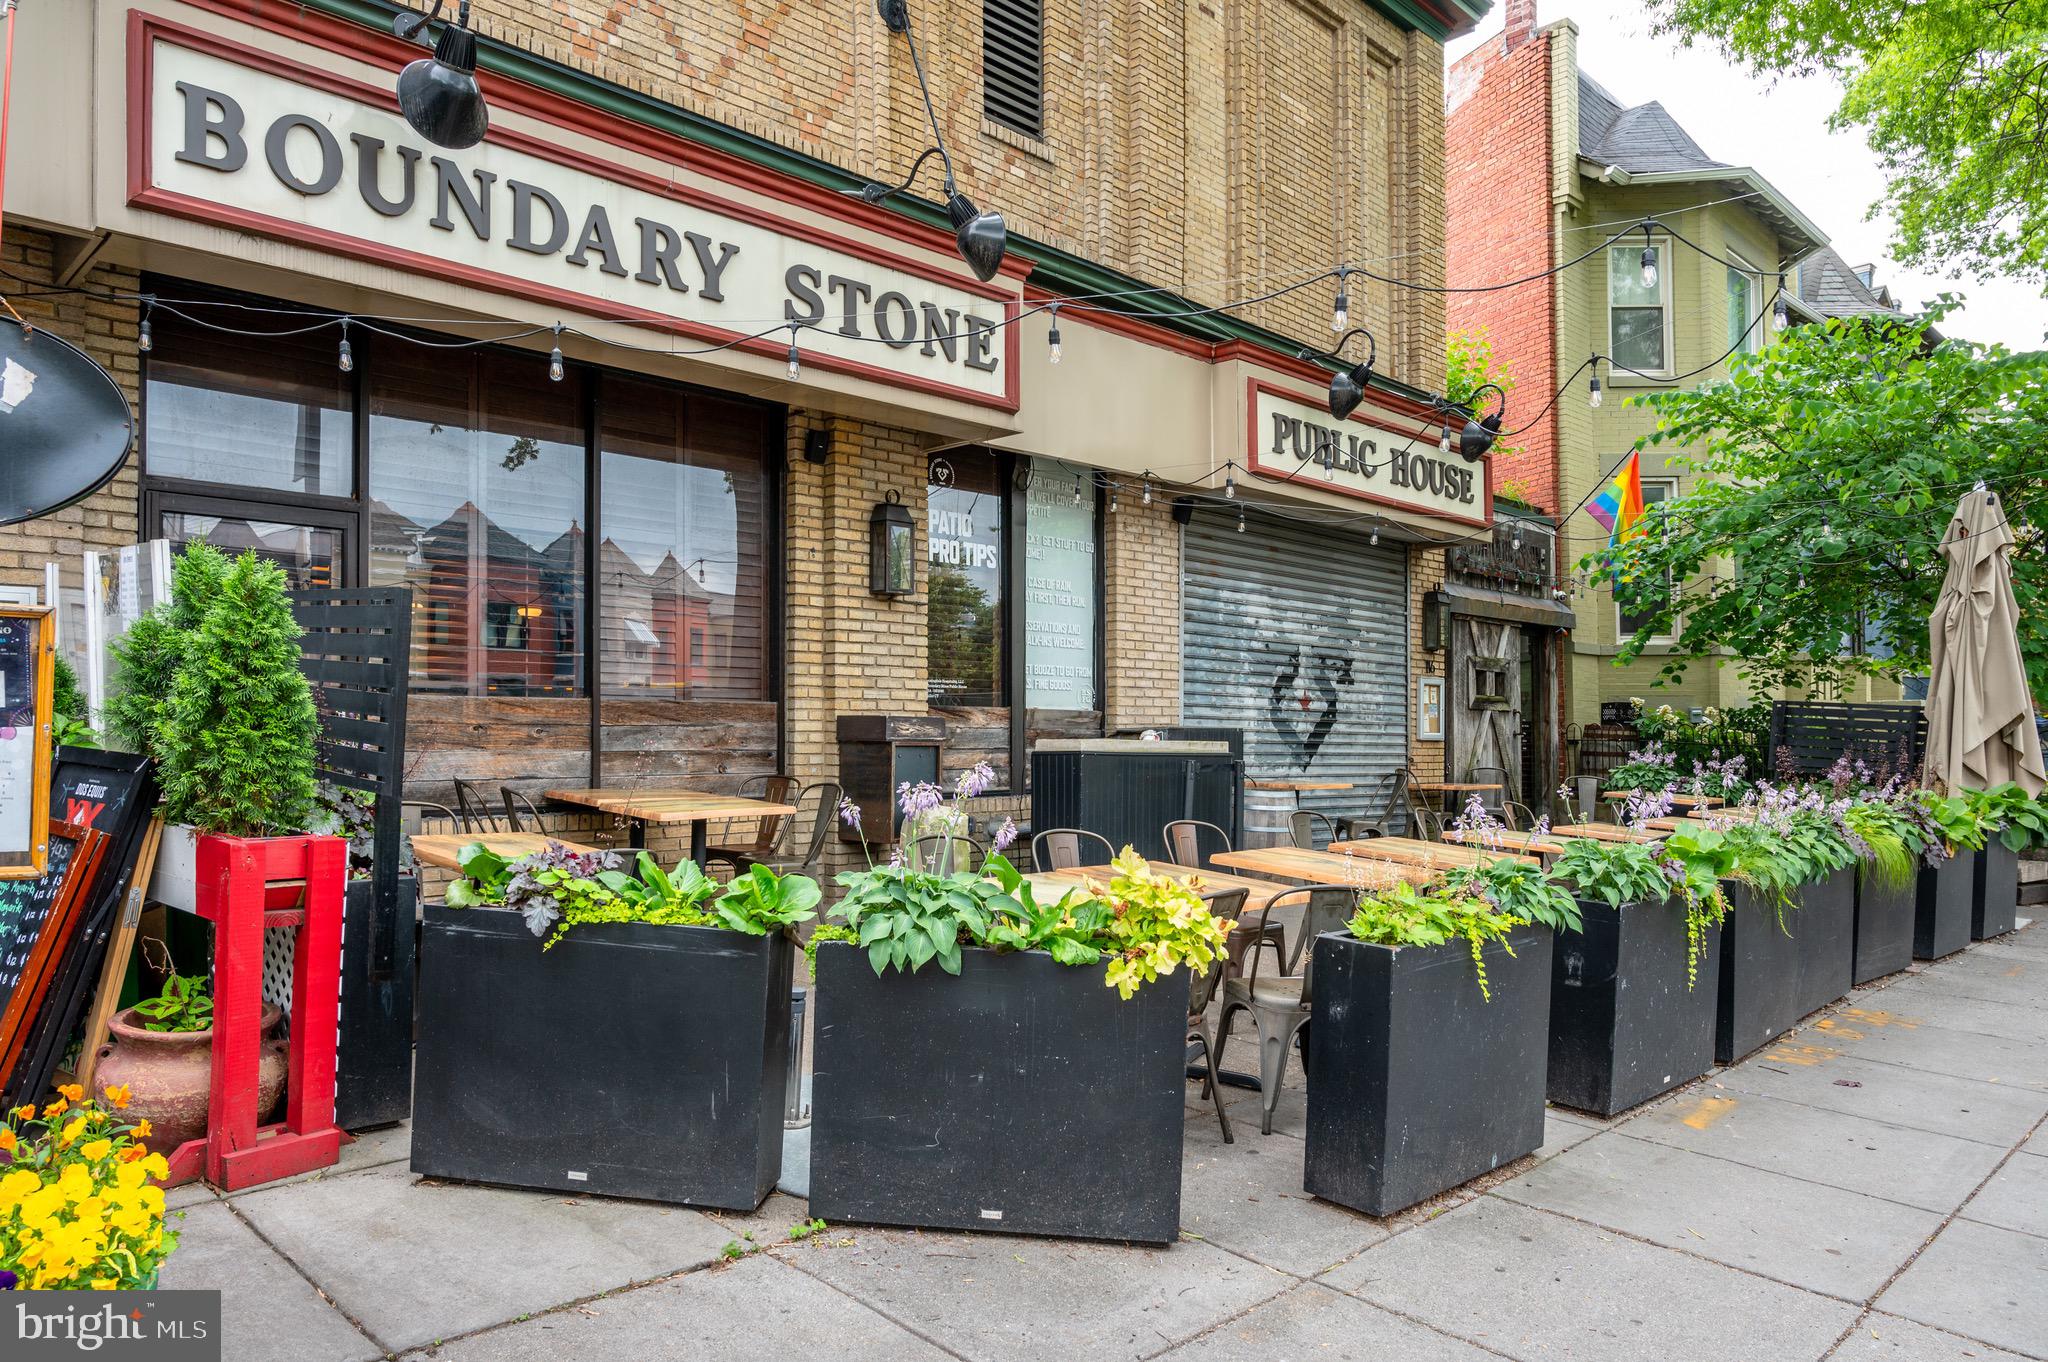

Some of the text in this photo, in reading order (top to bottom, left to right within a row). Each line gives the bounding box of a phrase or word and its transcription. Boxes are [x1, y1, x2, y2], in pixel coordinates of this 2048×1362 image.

[175, 80, 999, 372] BOUNDARY STONE
[1272, 412, 1475, 504] PUBLIC HOUSE
[1026, 503, 1051, 518] PPETITE
[929, 509, 973, 537] PATIO
[929, 537, 997, 569] PRO TIPS
[1054, 594, 1071, 606] THEN
[1067, 623, 1081, 635] AND
[1026, 634, 1052, 647] ALK-INS
[1034, 664, 1054, 676] BOOZE
[75, 783, 108, 798] DOS EQUIS
